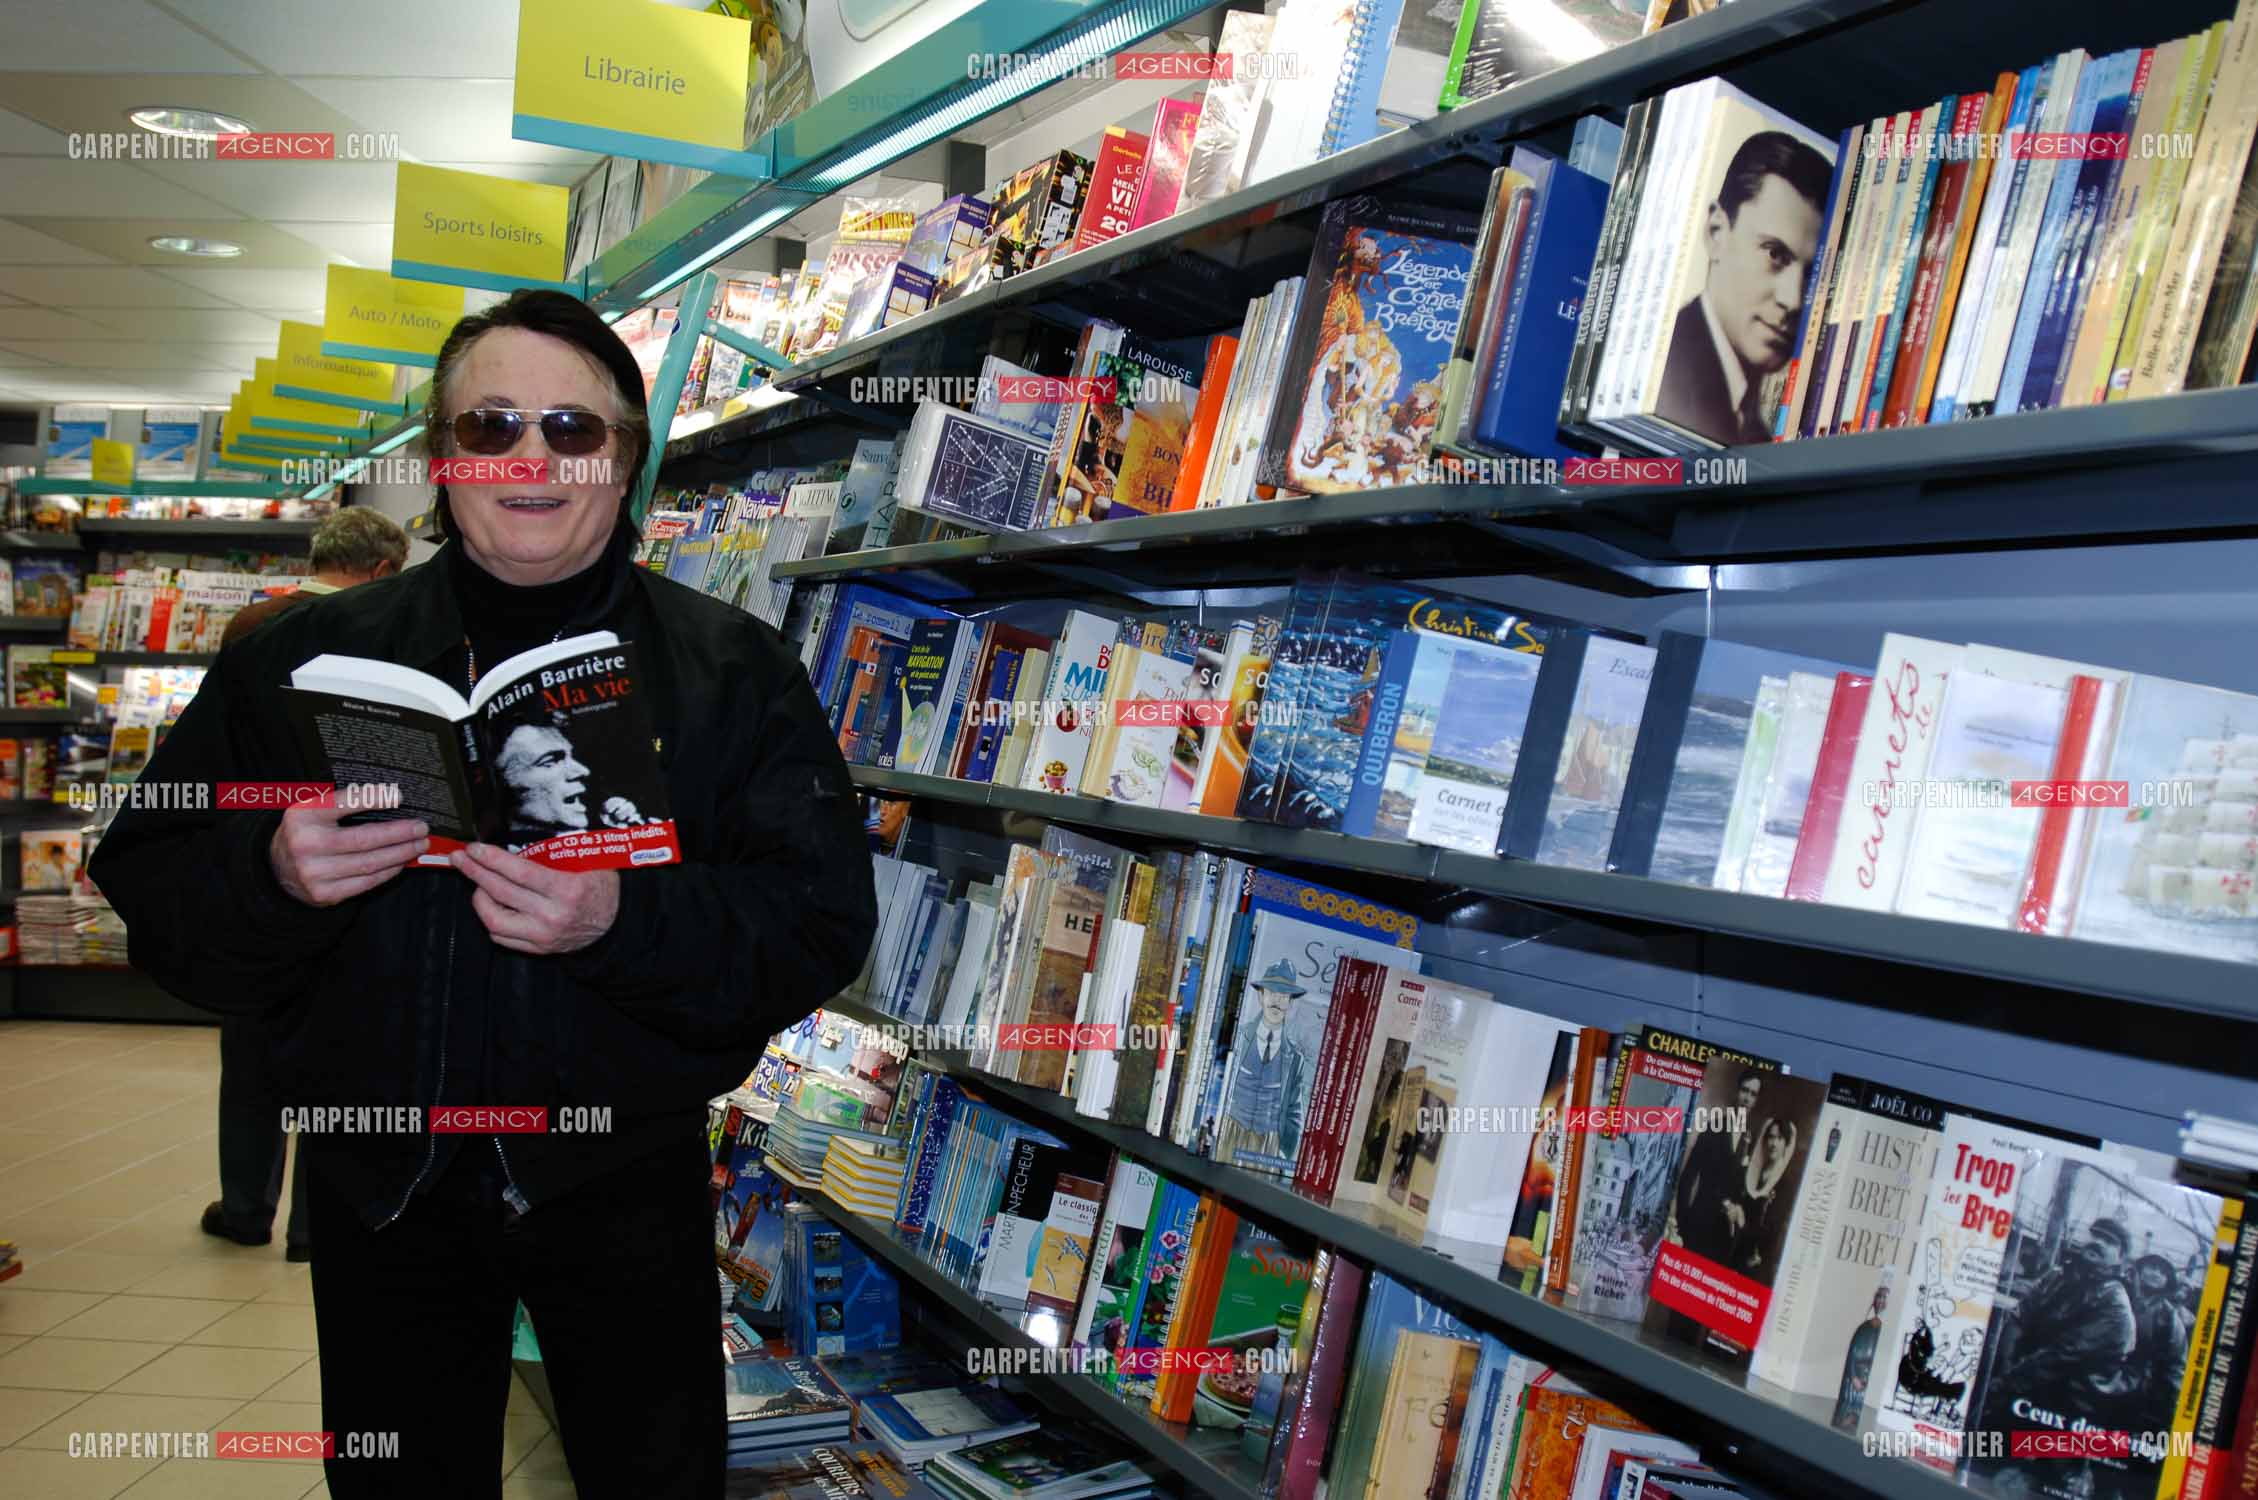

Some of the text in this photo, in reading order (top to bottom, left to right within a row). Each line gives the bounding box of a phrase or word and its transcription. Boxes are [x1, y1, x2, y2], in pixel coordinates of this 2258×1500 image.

[584, 55, 686, 96] Librairie
[1116, 164, 1133, 176] LE
[423, 211, 543, 247] Sports loisirs
[1384, 249, 1476, 287] Légende
[350, 306, 387, 324] Auto
[400, 312, 442, 330] Moto
[1374, 302, 1460, 343] Bretagn
[1558, 302, 1575, 320] LE
[293, 354, 378, 380] Informatique
[1127, 347, 1192, 383] LAROUSSE
[907, 655, 945, 670] NAVIGATION
[487, 655, 627, 719] Alain Barrière
[543, 672, 632, 713] Ma vie
[1361, 682, 1403, 787] QUIBERON
[1857, 658, 1920, 889] carnets
[1437, 788, 1491, 813] Carnet
[549, 849, 577, 860] écrits
[578, 848, 601, 859] pour
[603, 844, 627, 855] vous
[563, 837, 578, 848] CD
[595, 834, 602, 844] 3
[1648, 1031, 1716, 1062] CHARLES
[1871, 1092, 1910, 1118] JOËL
[1954, 1143, 2015, 1198] Trop
[1058, 1196, 1068, 1207] Le
[1961, 1193, 2012, 1240] Bre
[1093, 1218, 1115, 1282] Jardin
[2230, 1222, 2258, 1287] SOLAIRE
[2216, 1286, 2248, 1347] TEMPLE
[2212, 1351, 2233, 1373] DU
[2011, 1398, 2065, 1429] Ceux
[2195, 1374, 2230, 1440] L'ORDRE
[812, 1447, 865, 1495] COUREURS
